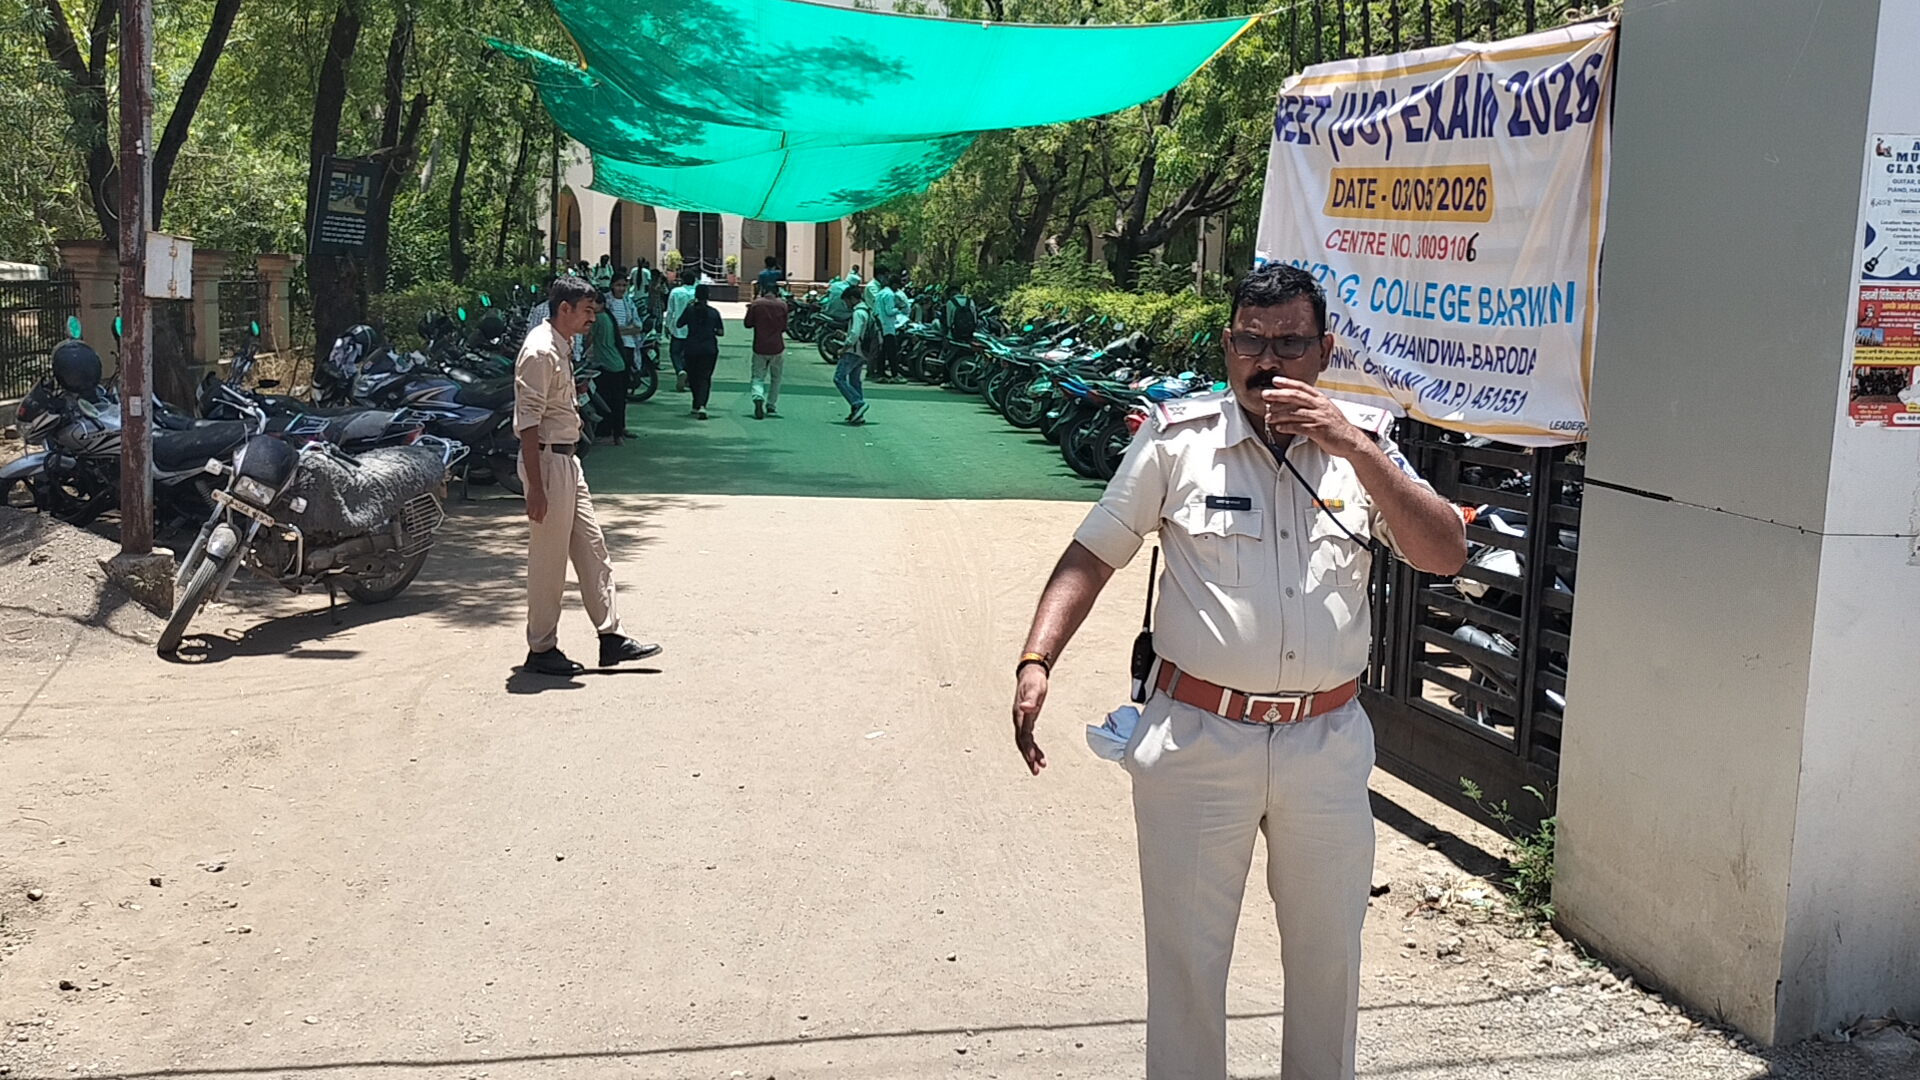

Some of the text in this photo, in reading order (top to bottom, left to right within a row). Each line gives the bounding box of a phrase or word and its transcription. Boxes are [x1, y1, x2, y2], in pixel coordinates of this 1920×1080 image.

[1400, 72, 1499, 142] EXAM
[1504, 53, 1603, 137] 2026
[1332, 178, 1377, 209] DATE
[1325, 229, 1387, 256] CENTRE
[1390, 233, 1412, 258] NO.
[1370, 277, 1472, 323] COLLEGE
[1478, 281, 1575, 327] BARWNI
[1376, 331, 1538, 376] KHANDWA-BARODA
[1418, 378, 1472, 411] (M.P.)
[1471, 385, 1529, 415] 451551
[1549, 420, 1586, 431] LEADER
